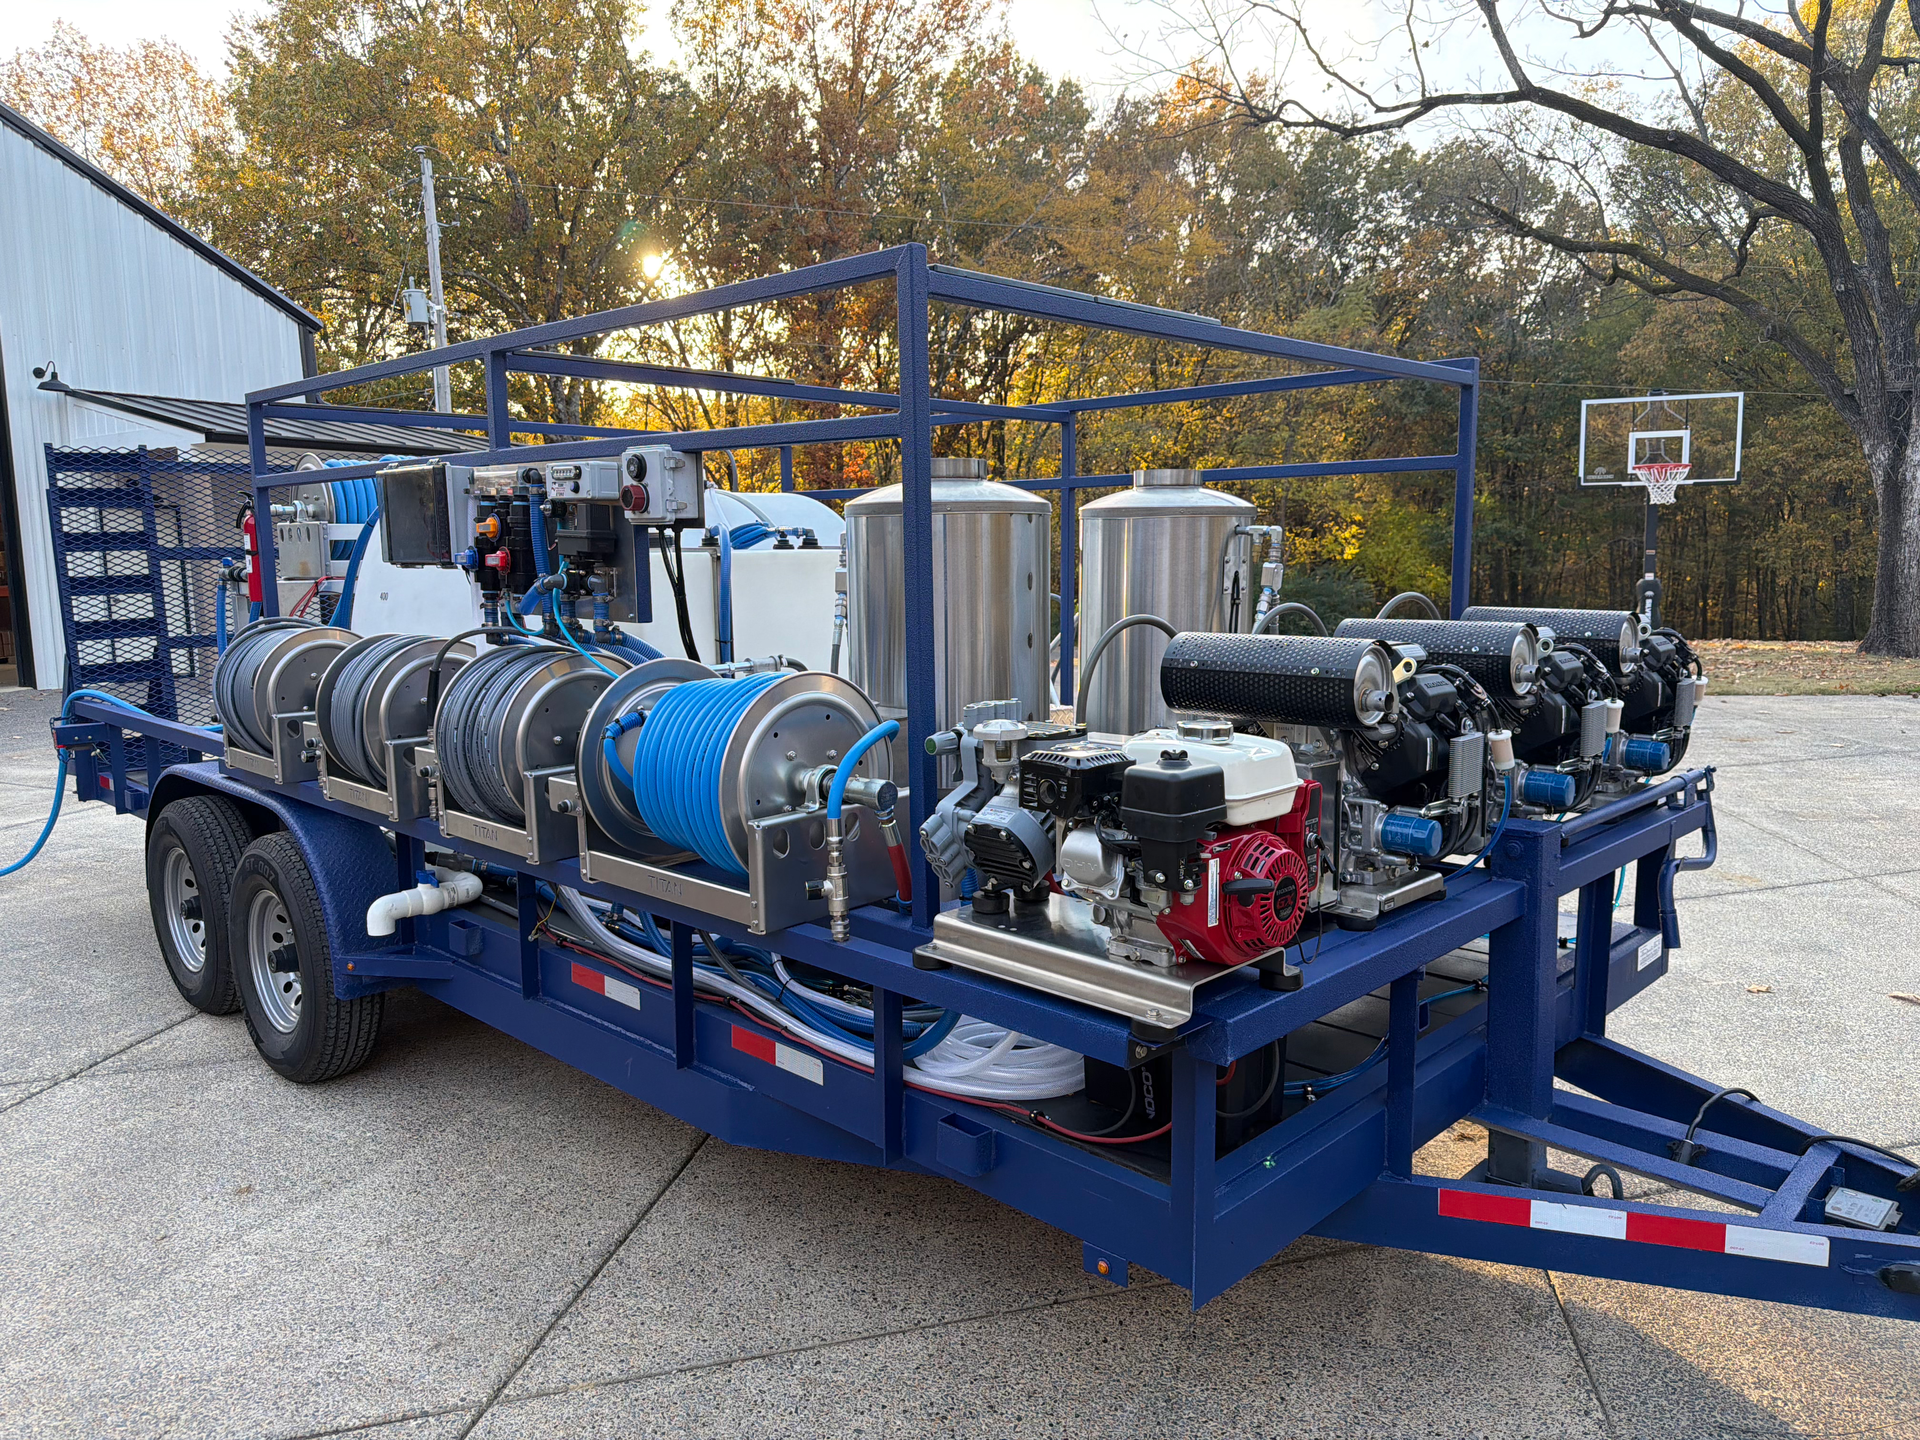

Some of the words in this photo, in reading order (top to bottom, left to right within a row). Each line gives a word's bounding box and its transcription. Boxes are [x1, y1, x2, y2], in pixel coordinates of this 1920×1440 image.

[380, 591, 389, 601] 400
[472, 823, 498, 841] TITAN
[1061, 857, 1099, 873] OHV
[647, 874, 683, 896] TITAN
[1276, 893, 1295, 909] GX
